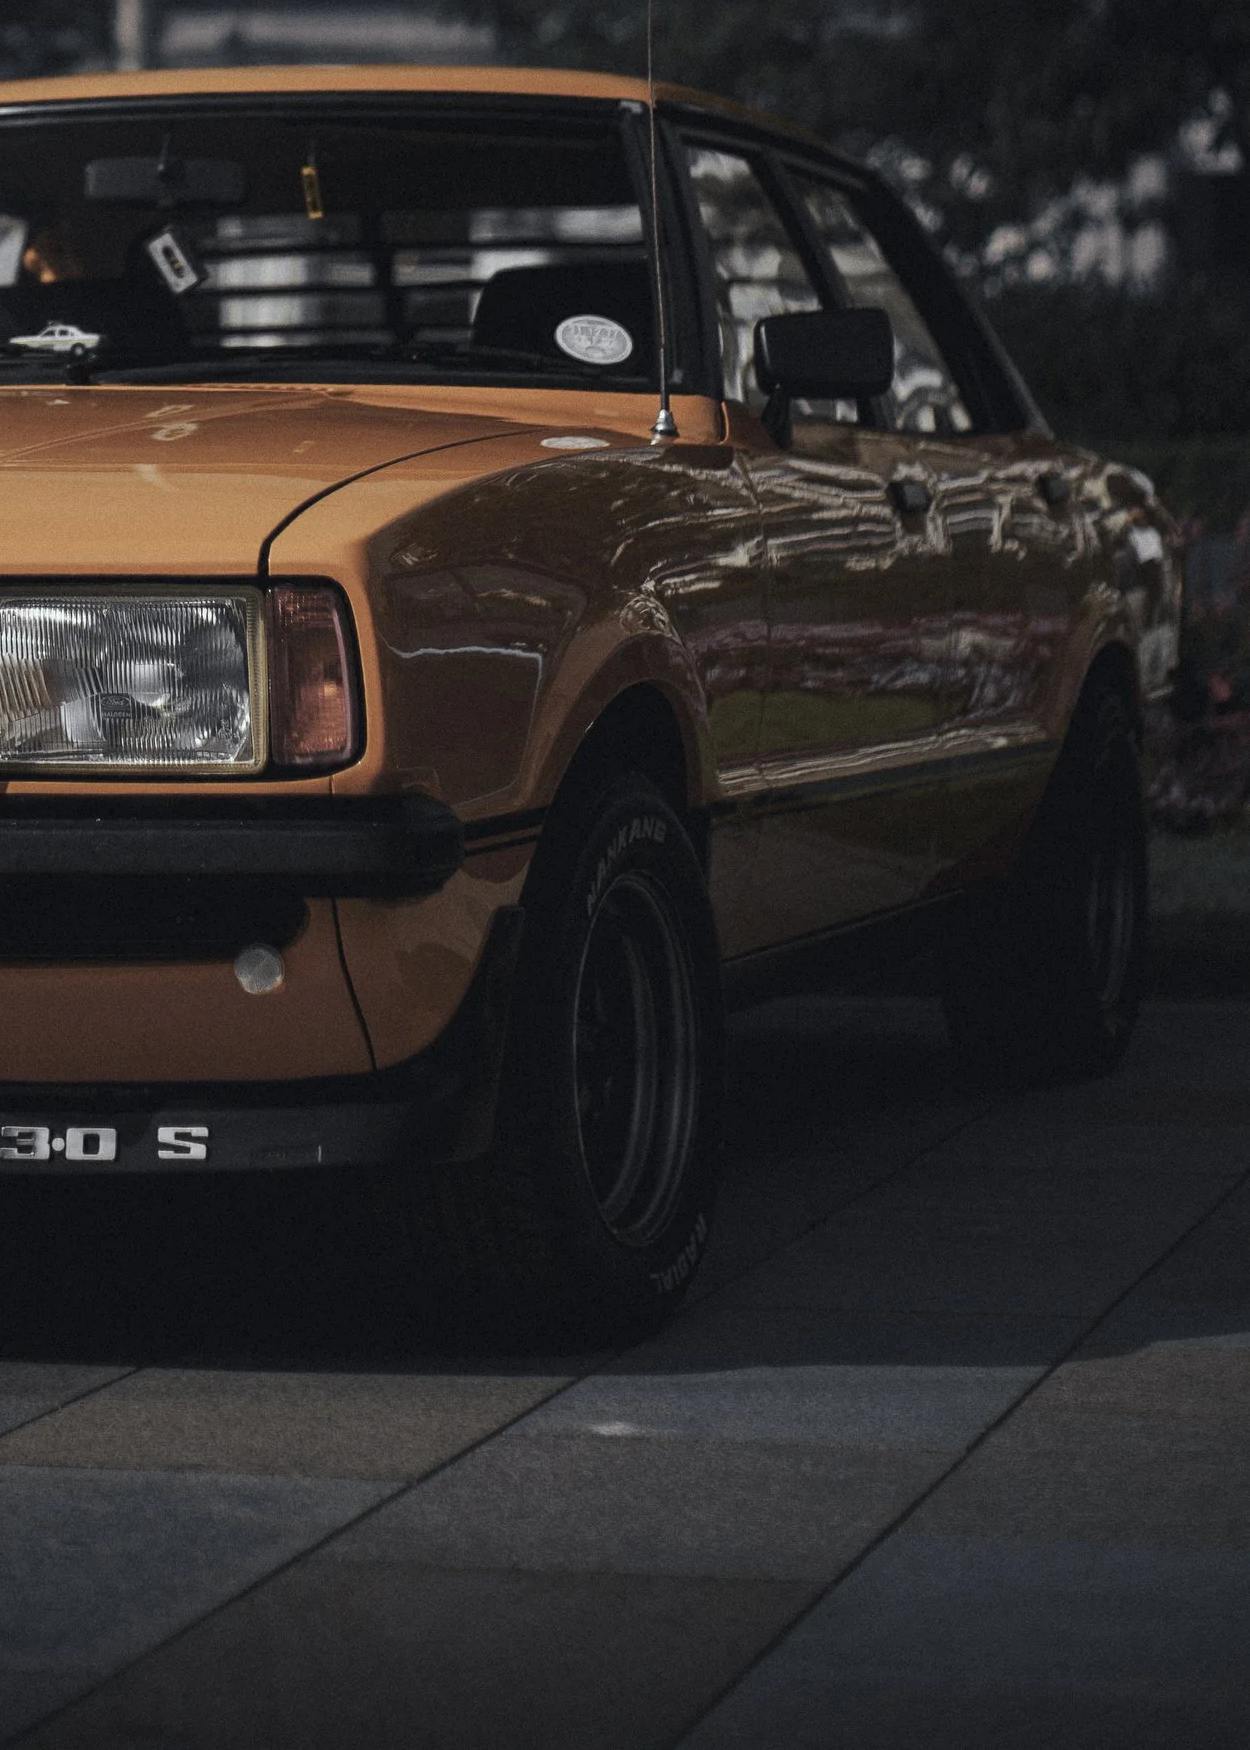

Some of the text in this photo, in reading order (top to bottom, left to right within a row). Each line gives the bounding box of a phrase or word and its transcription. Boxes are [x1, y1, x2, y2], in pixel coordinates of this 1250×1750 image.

[586, 815, 667, 917] NANKANG
[157, 1126, 210, 1161] S
[649, 1212, 707, 1295] RADIAL
